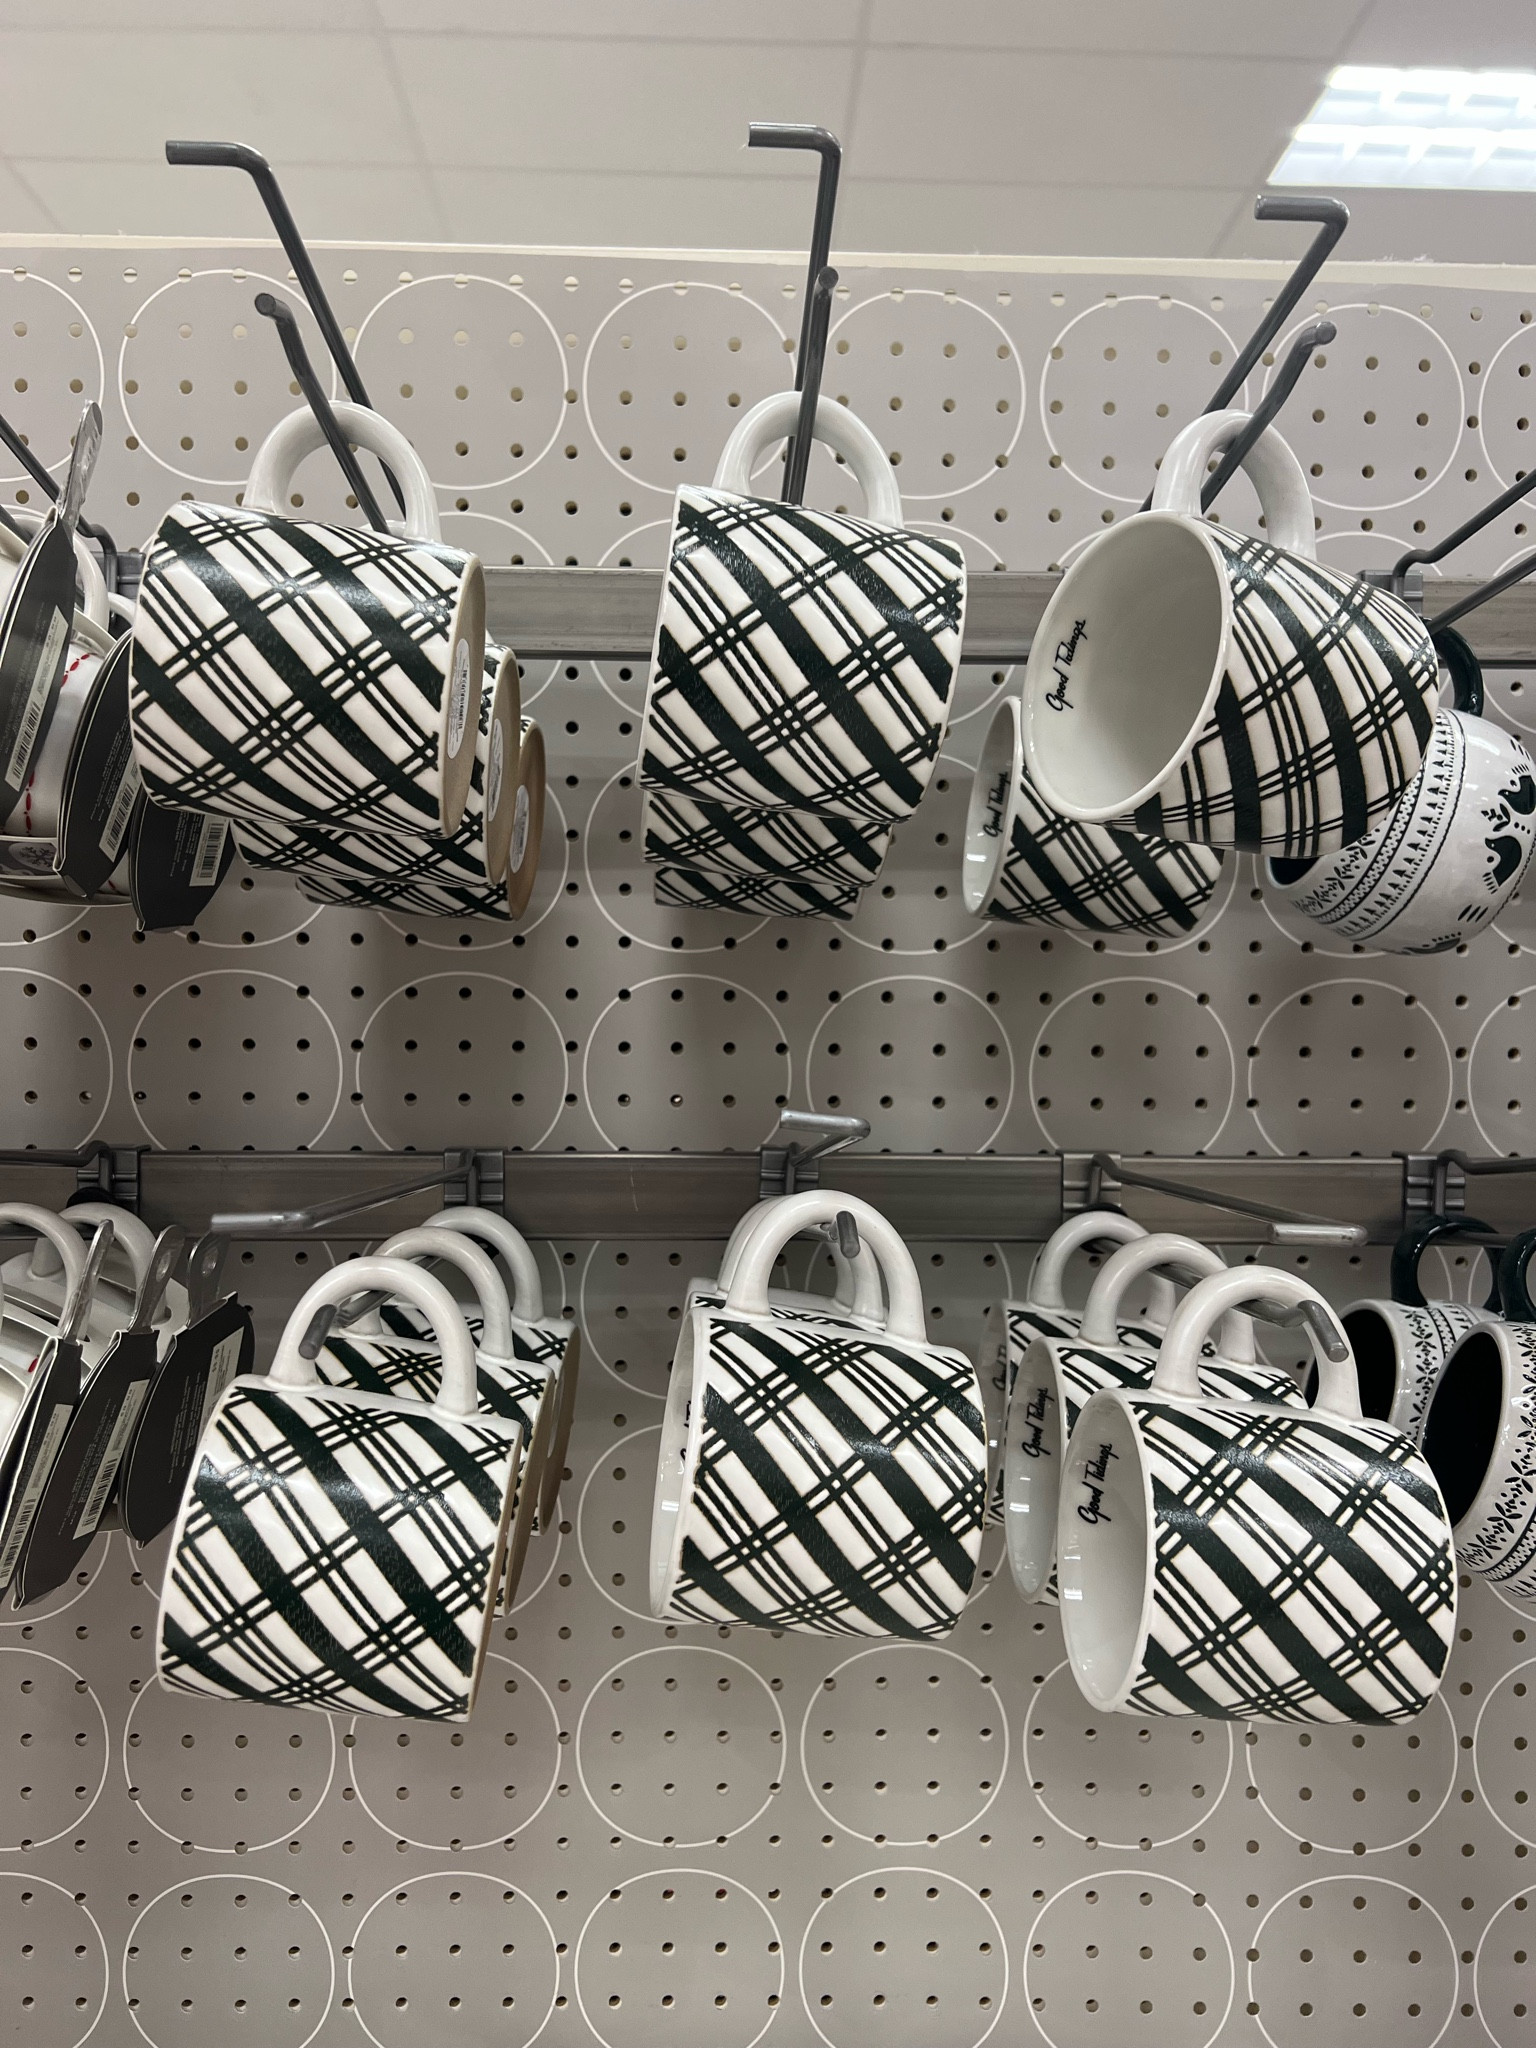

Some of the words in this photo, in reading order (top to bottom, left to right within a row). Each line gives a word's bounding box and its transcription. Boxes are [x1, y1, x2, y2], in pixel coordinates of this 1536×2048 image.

[1055, 619, 1088, 666] Tidings
[1046, 666, 1074, 711] Good
[983, 805, 1003, 837] Good
[1026, 1387, 1055, 1421] Tidings
[1022, 1421, 1051, 1458] Good
[1085, 1443, 1119, 1482] Tidings
[1078, 1481, 1111, 1524] Good
